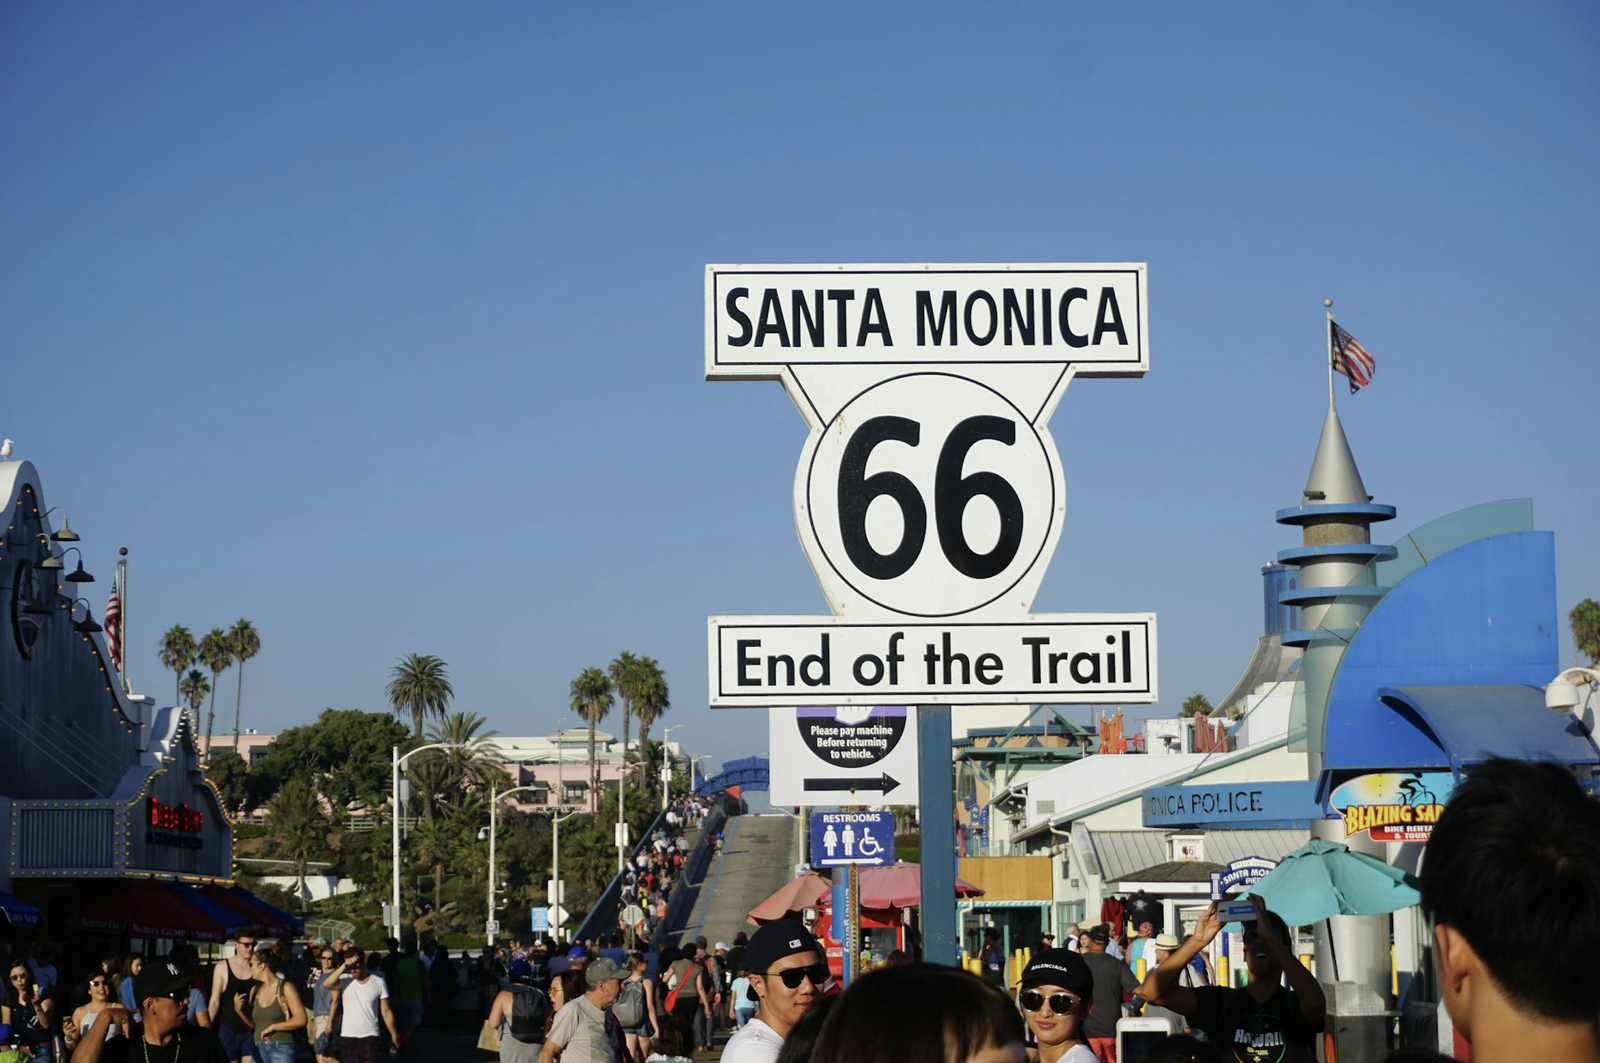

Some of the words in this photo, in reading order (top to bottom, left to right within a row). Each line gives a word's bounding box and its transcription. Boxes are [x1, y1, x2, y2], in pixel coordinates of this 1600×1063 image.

[726, 288, 893, 348] SANTA
[915, 287, 1128, 348] MONICA
[837, 414, 1024, 580] 66
[737, 634, 830, 687] End
[853, 632, 905, 686] of
[924, 632, 1004, 685] the
[1022, 631, 1132, 685] Trail
[811, 726, 838, 735] Please
[840, 727, 855, 737] pay
[857, 725, 893, 735] machine
[817, 738, 845, 747] Before
[846, 737, 887, 748] returning
[830, 750, 840, 759] to
[841, 749, 874, 759] vehicle.
[1192, 791, 1262, 814] POLICE
[823, 814, 881, 823] RESTROOMS
[1345, 804, 1412, 836] BLAZING
[1384, 825, 1404, 833] BIKE
[1223, 869, 1249, 885] SANTA
[1233, 1028, 1284, 1048] HAWAII
